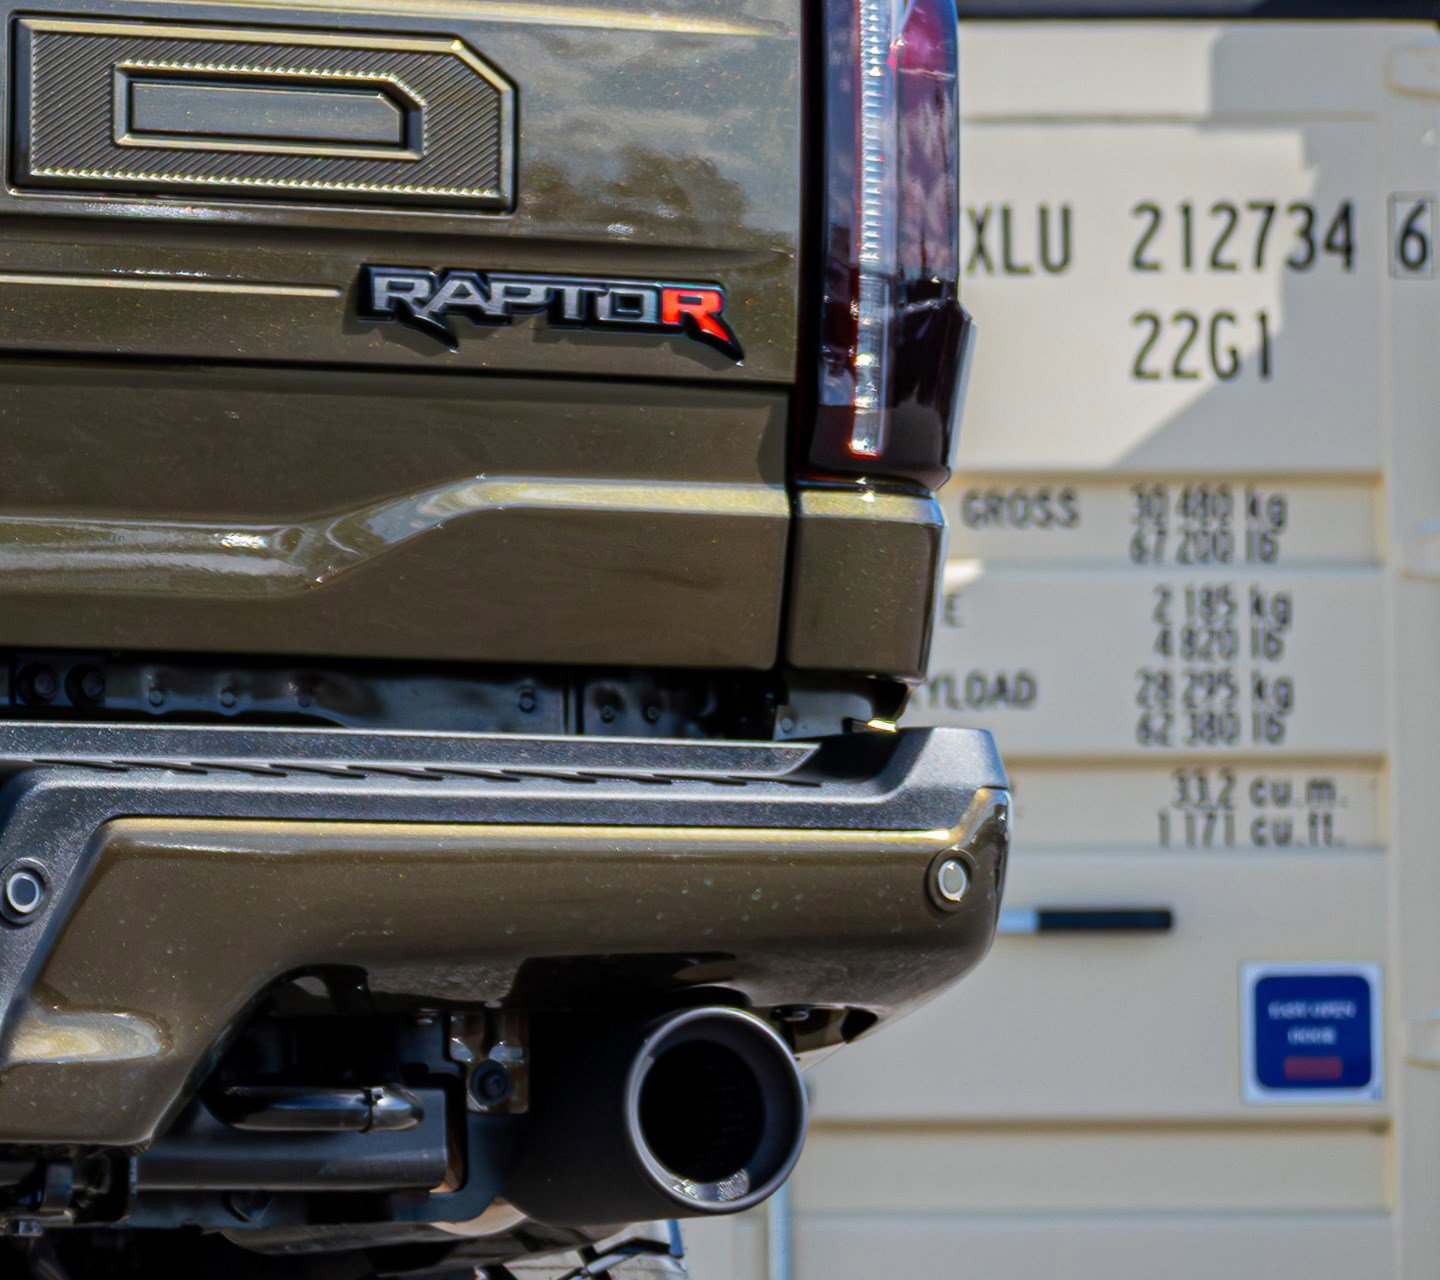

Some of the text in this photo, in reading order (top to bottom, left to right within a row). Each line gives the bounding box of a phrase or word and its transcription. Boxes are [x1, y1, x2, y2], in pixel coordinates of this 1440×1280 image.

[965, 200, 1431, 274] XLU 212734 6
[362, 266, 742, 360] RAPTOR
[1130, 309, 1274, 384] 22G1
[961, 488, 1081, 530] GROSS
[1244, 484, 1289, 531] kg
[1177, 527, 1234, 564] 200
[1245, 528, 1280, 564] lb
[1248, 586, 1293, 632] kg
[1250, 627, 1285, 661] lb
[914, 671, 1038, 710] YLOAD
[1250, 672, 1295, 718] kg
[1251, 712, 1286, 746] lb
